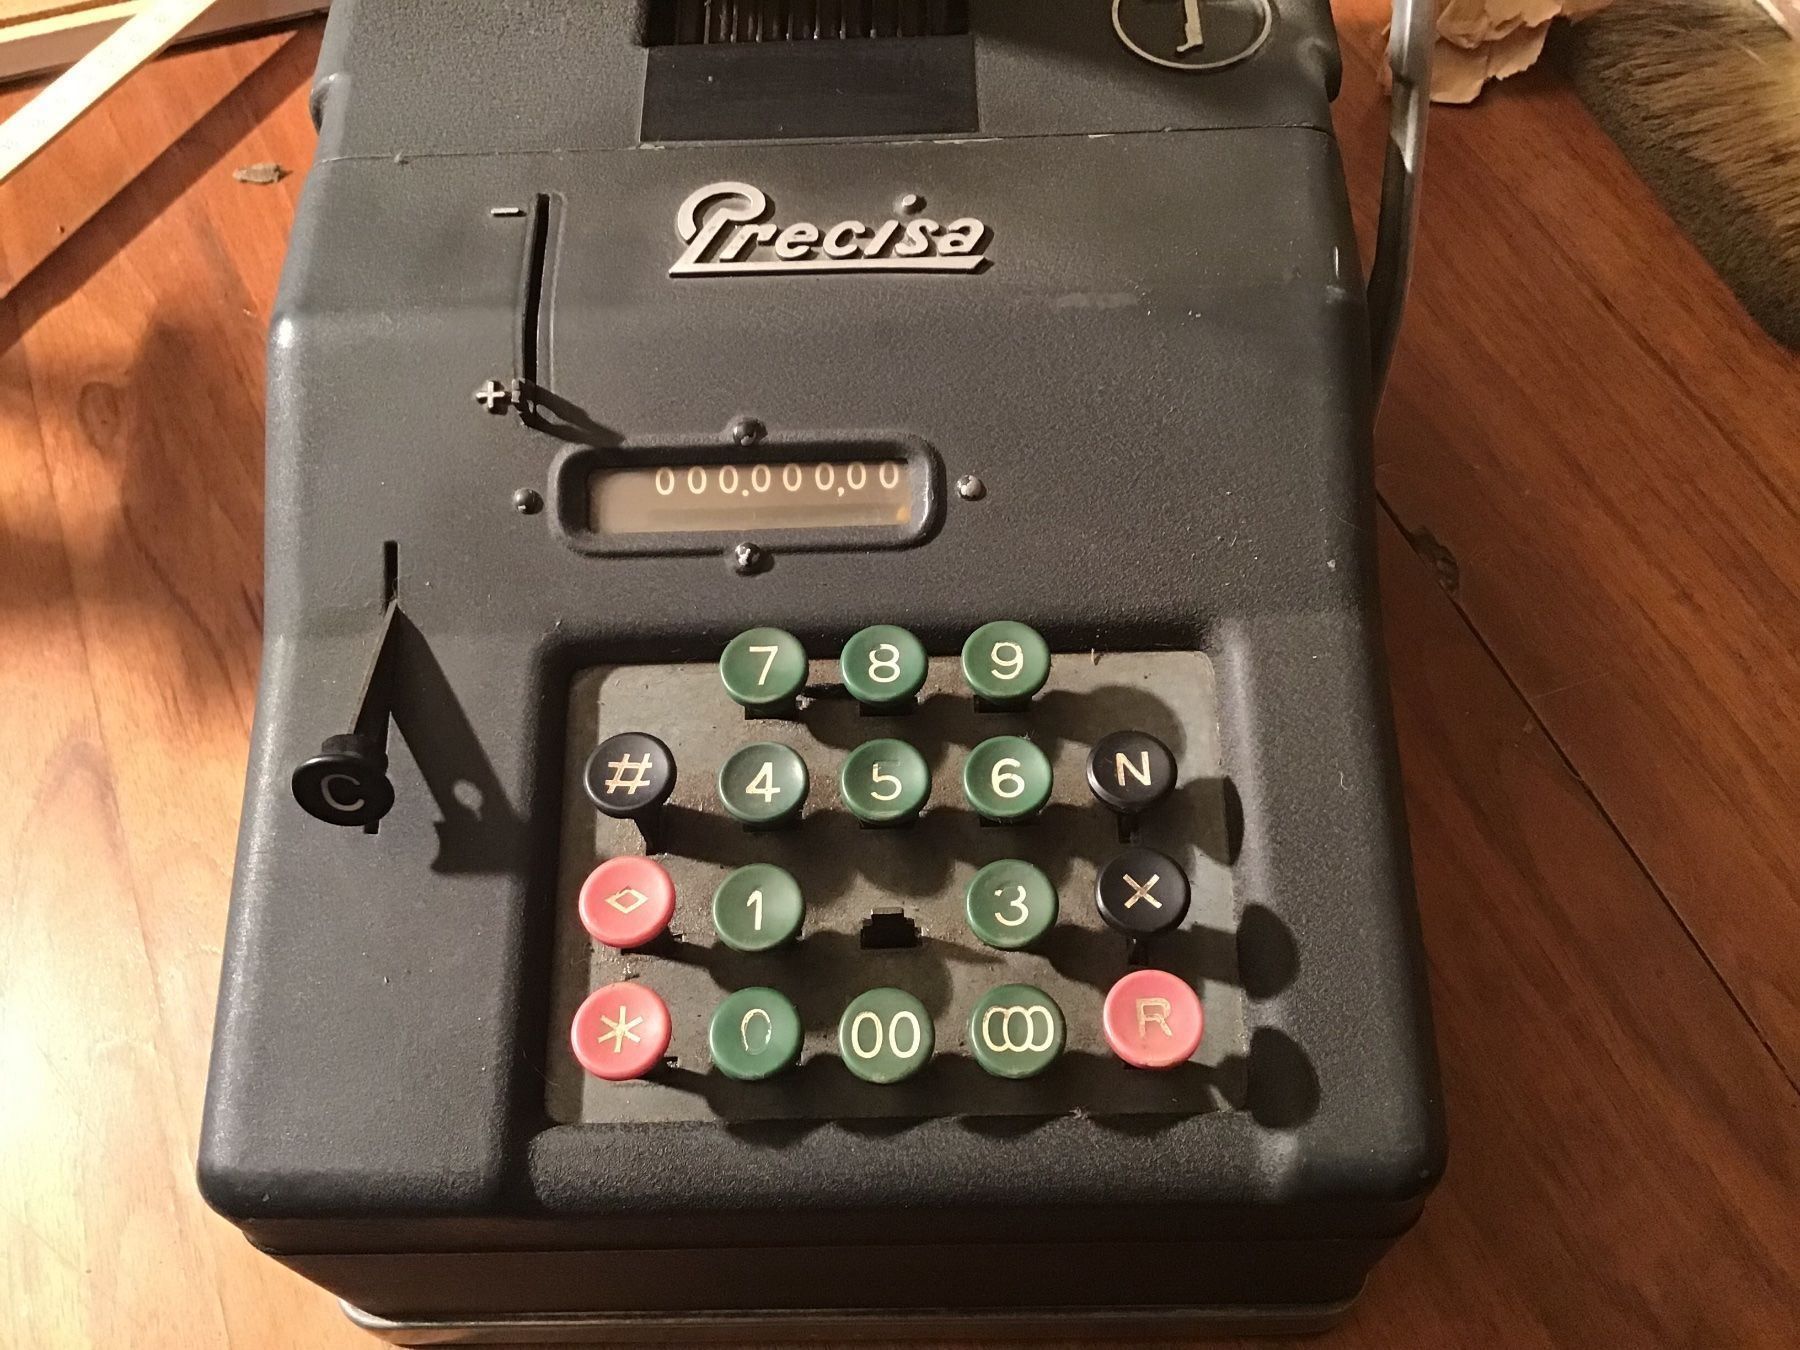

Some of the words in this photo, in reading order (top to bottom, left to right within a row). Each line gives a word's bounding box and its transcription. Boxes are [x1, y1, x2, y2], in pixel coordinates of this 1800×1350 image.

[669, 180, 991, 276] Precisa
[749, 645, 779, 686] 7
[868, 642, 901, 684] 8
[990, 641, 1025, 681] 9
[745, 761, 781, 803] 4
[870, 760, 903, 801] 5
[990, 757, 1026, 799] 6
[1115, 750, 1151, 788] N
[321, 774, 365, 812] C
[745, 889, 765, 931] 1
[994, 885, 1029, 926] 3
[850, 1010, 922, 1059] 00
[1136, 997, 1174, 1040] R
